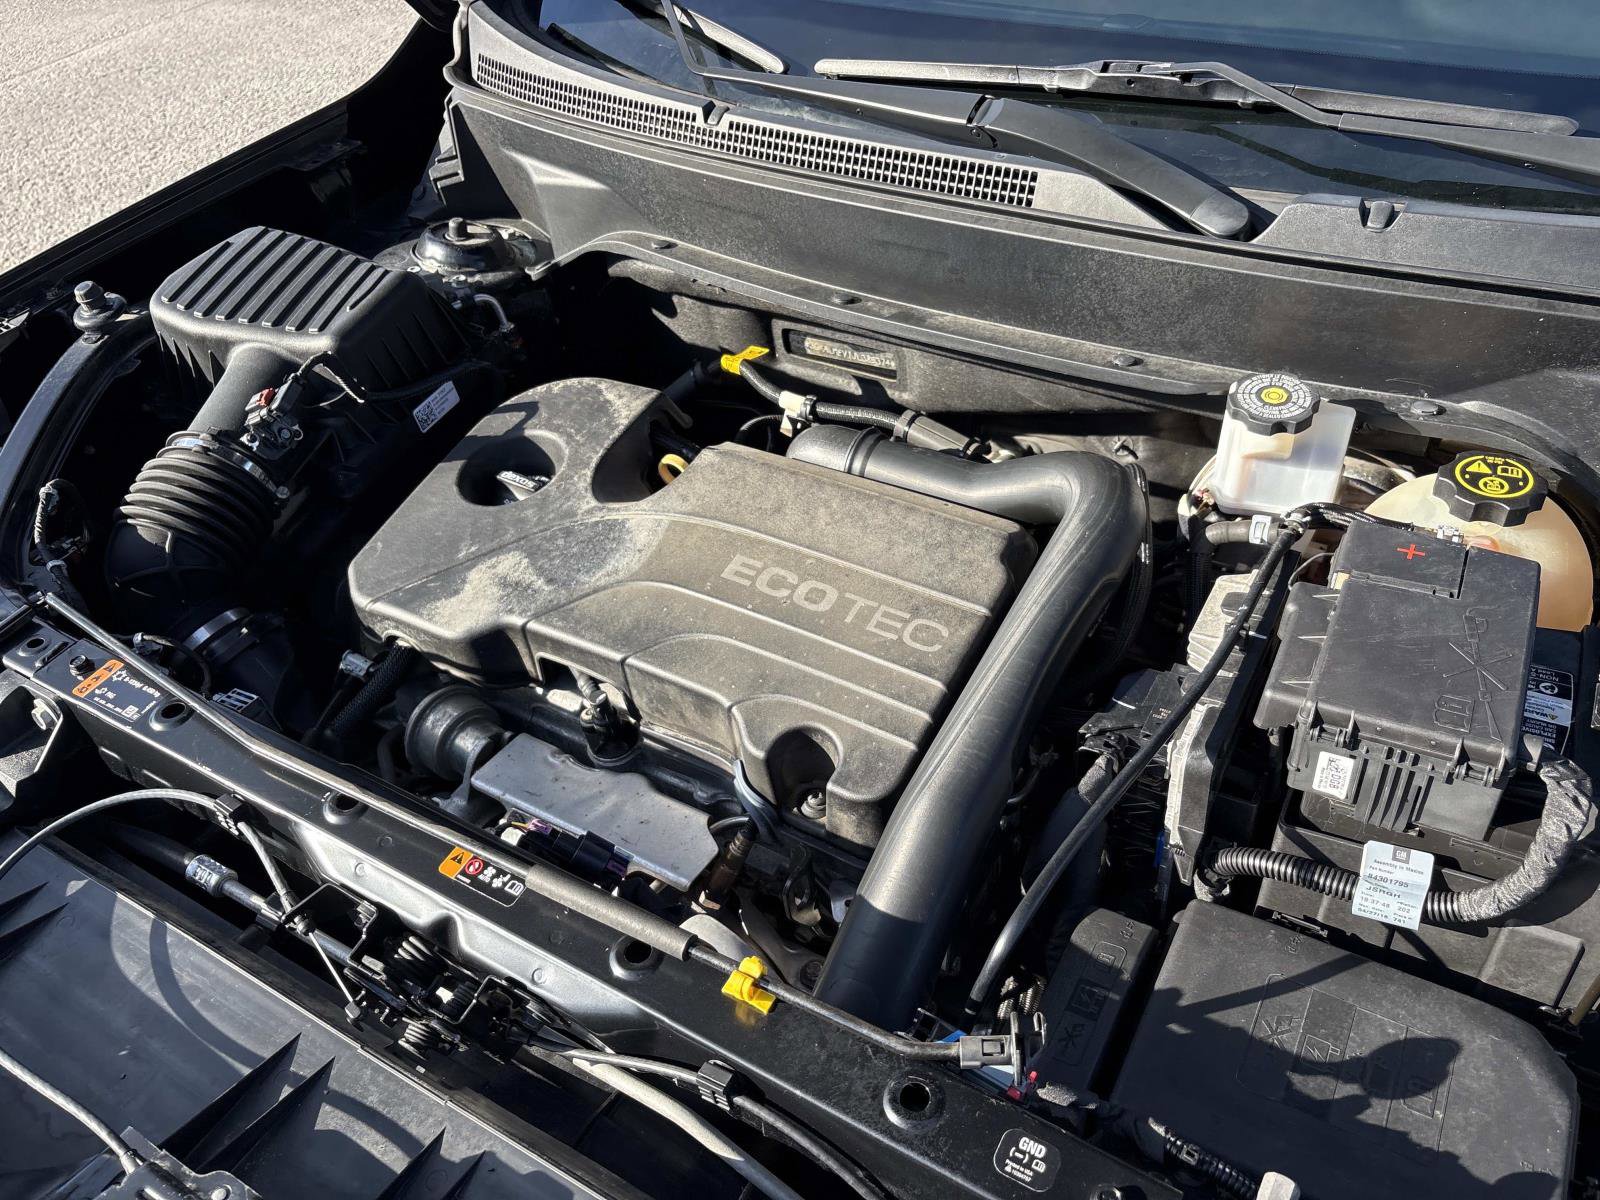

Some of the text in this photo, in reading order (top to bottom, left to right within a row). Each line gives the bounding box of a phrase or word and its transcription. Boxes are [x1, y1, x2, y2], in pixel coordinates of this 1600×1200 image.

[720, 553, 949, 653] ECOTEC
[1395, 850, 1407, 860] GM
[1018, 1136, 1047, 1159] GND
